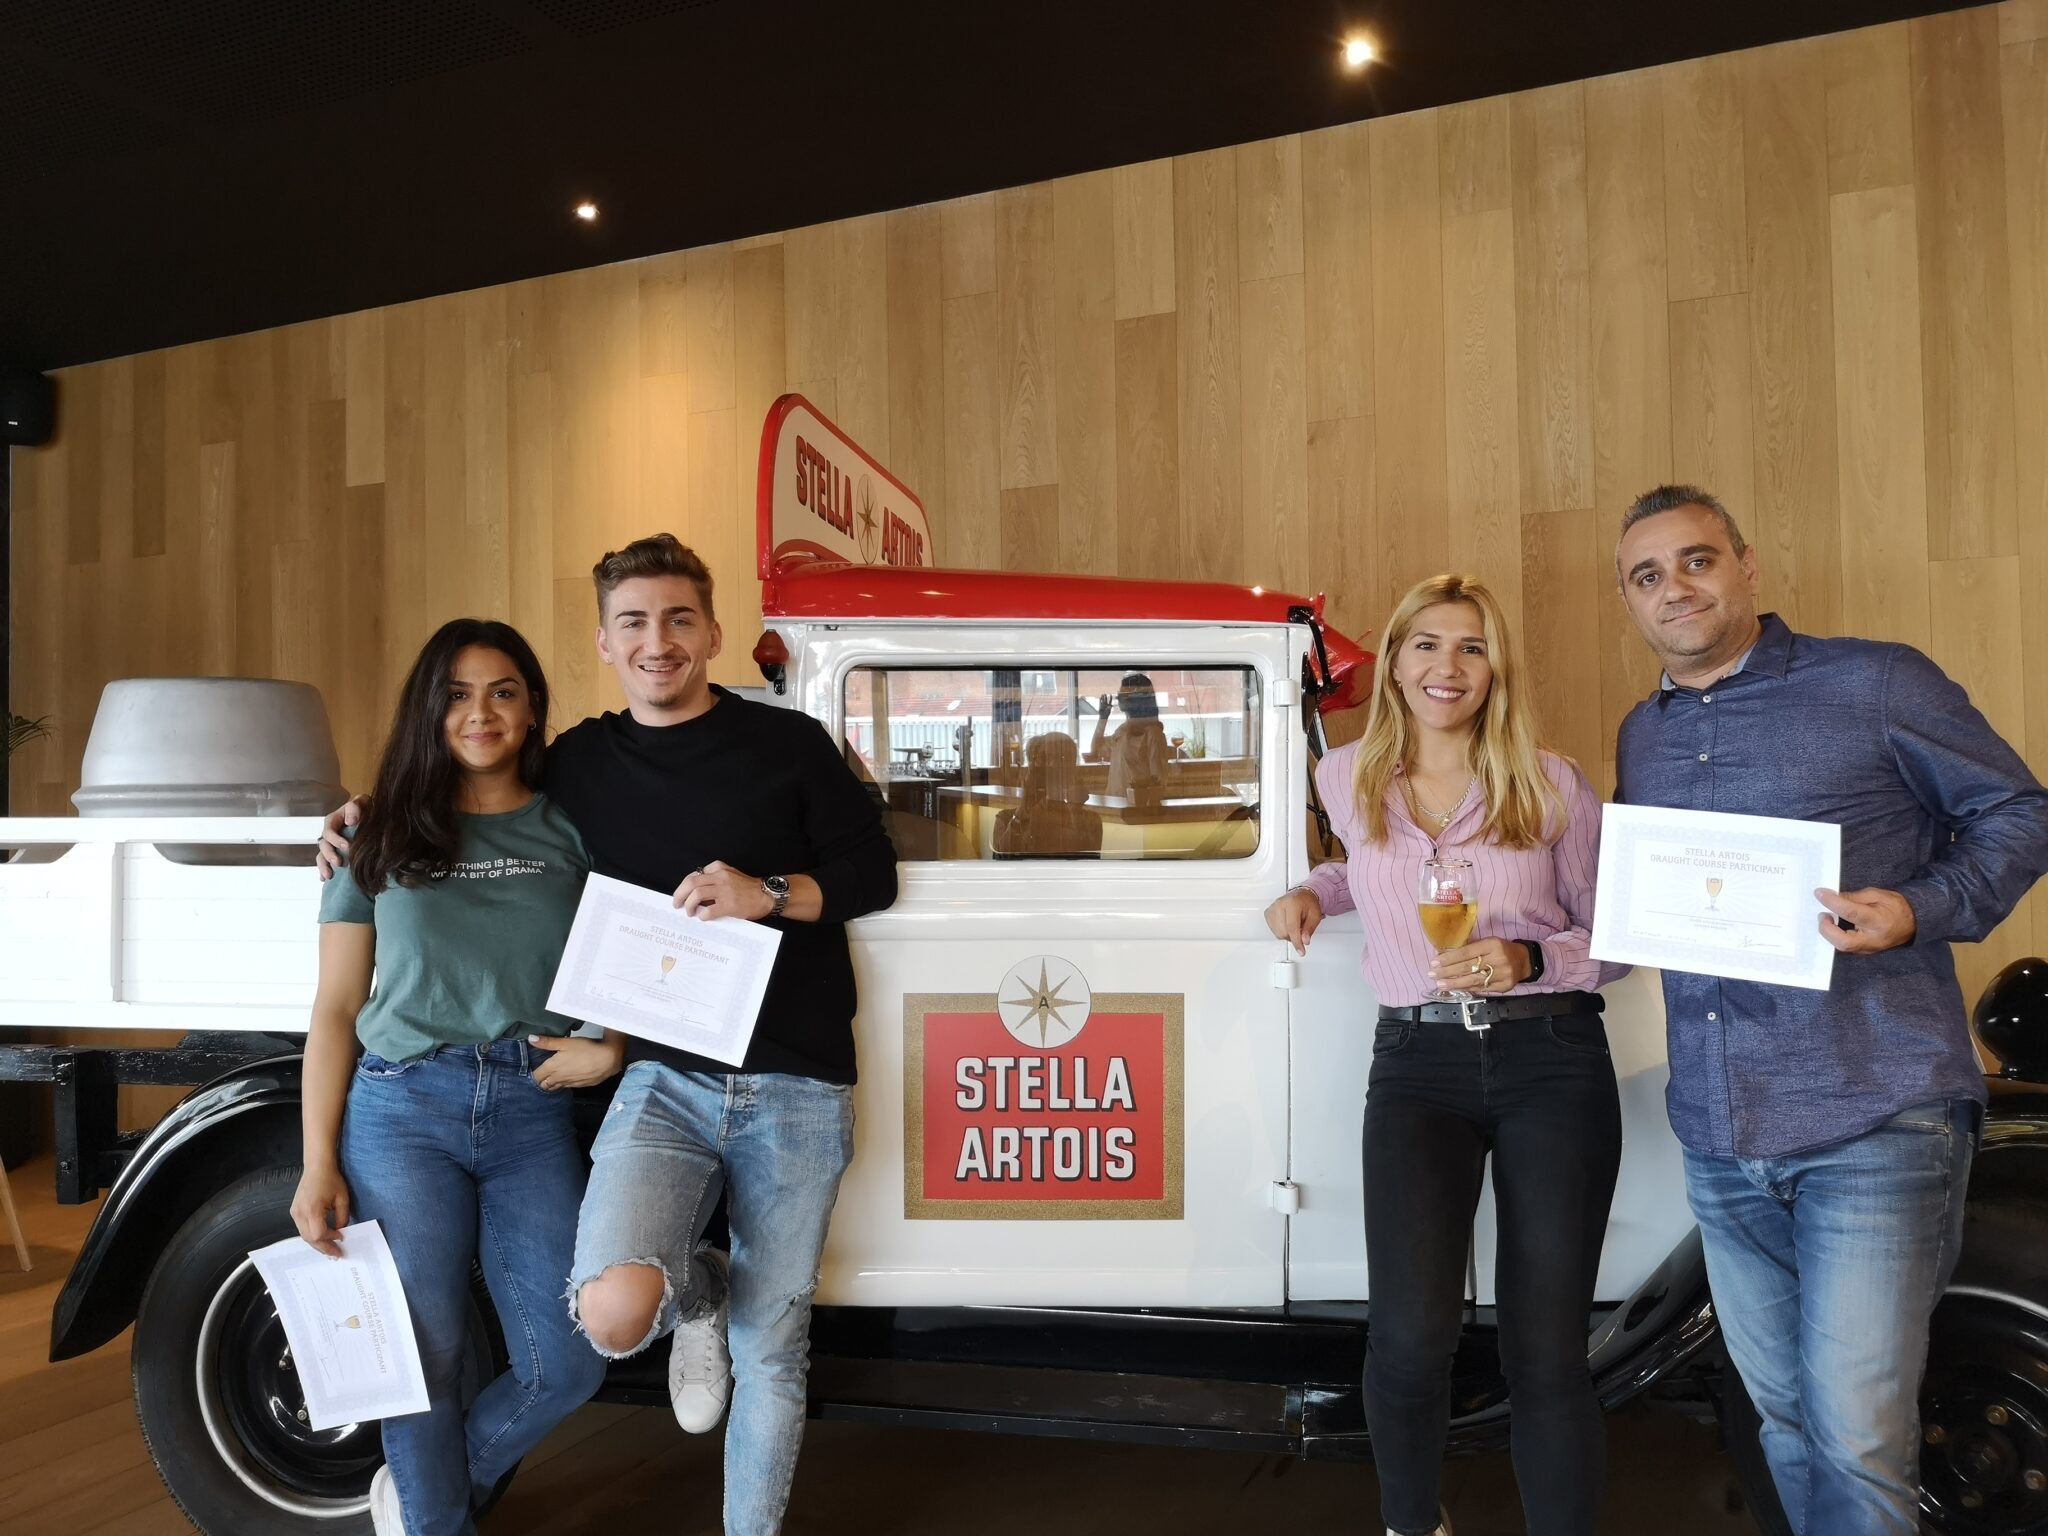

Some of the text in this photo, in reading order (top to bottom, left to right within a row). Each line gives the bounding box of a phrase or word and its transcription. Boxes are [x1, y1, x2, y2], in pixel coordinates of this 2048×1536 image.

[796, 435, 923, 566] STELLA ARTOIS
[494, 858, 504, 867] IS
[507, 858, 545, 867] BETTER
[1650, 854, 1786, 875] DRAUGHT COURSE PARTICIPANT
[1685, 847, 1750, 862] STELLA ARTOIS
[488, 870, 502, 878] OF
[505, 867, 543, 876] DRAMA
[618, 924, 730, 965] DRAUGHT COURSE PARTICIPANT
[650, 925, 704, 947] STELLA ARTOIS
[1038, 996, 1050, 1009] A
[955, 1056, 1137, 1112] STELLA
[954, 1126, 1137, 1181] ARTOIS
[350, 1266, 367, 1300] DRAUGHT
[362, 1300, 375, 1329] COURSE
[367, 1291, 379, 1318] STELLA
